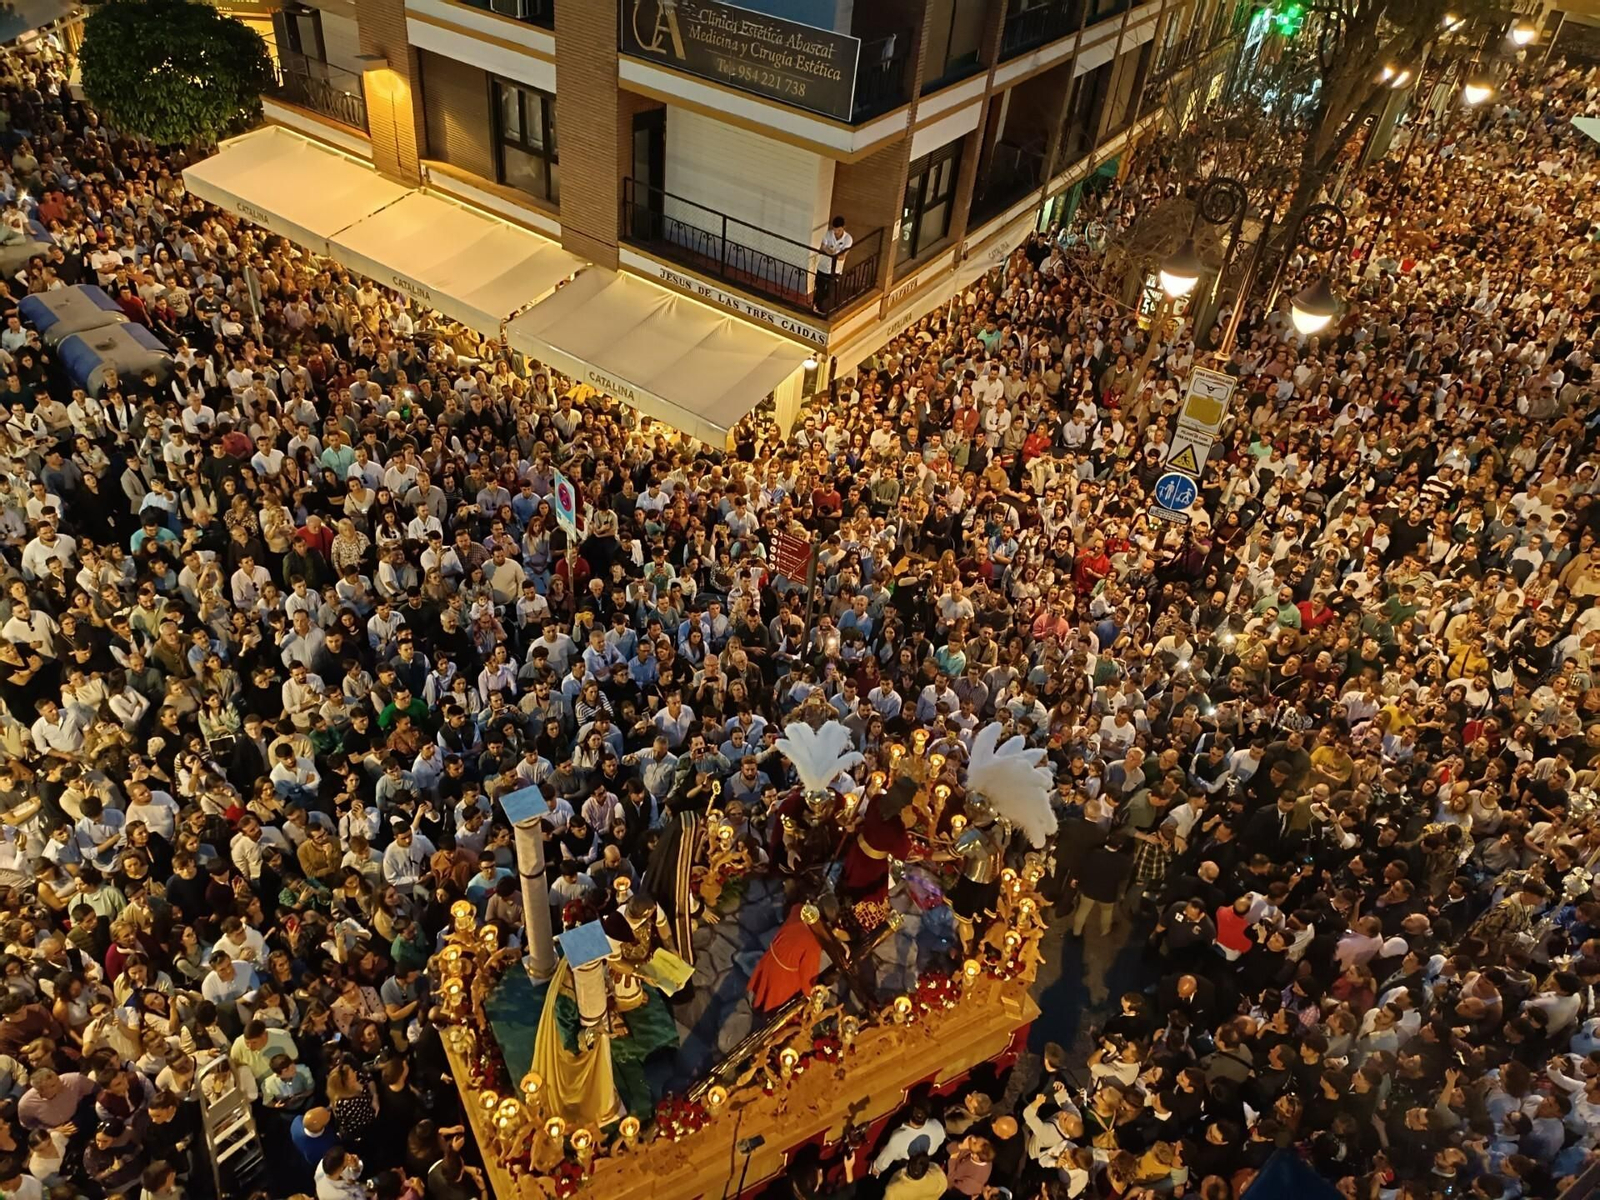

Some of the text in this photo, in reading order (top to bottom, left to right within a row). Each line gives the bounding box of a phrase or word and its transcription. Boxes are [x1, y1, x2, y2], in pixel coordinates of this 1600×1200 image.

[688, 24, 841, 81] Medicina y Cirugía Estética
[786, 33, 835, 59] Abascal
[738, 65, 759, 83] 954
[761, 71, 781, 90] 221
[785, 79, 806, 97] 738
[237, 202, 270, 225] CATALINA
[392, 276, 431, 302] CATALINA
[660, 267, 826, 346] JESUS DE LAS TRES CAIDAS
[588, 371, 635, 402] CATALINA
